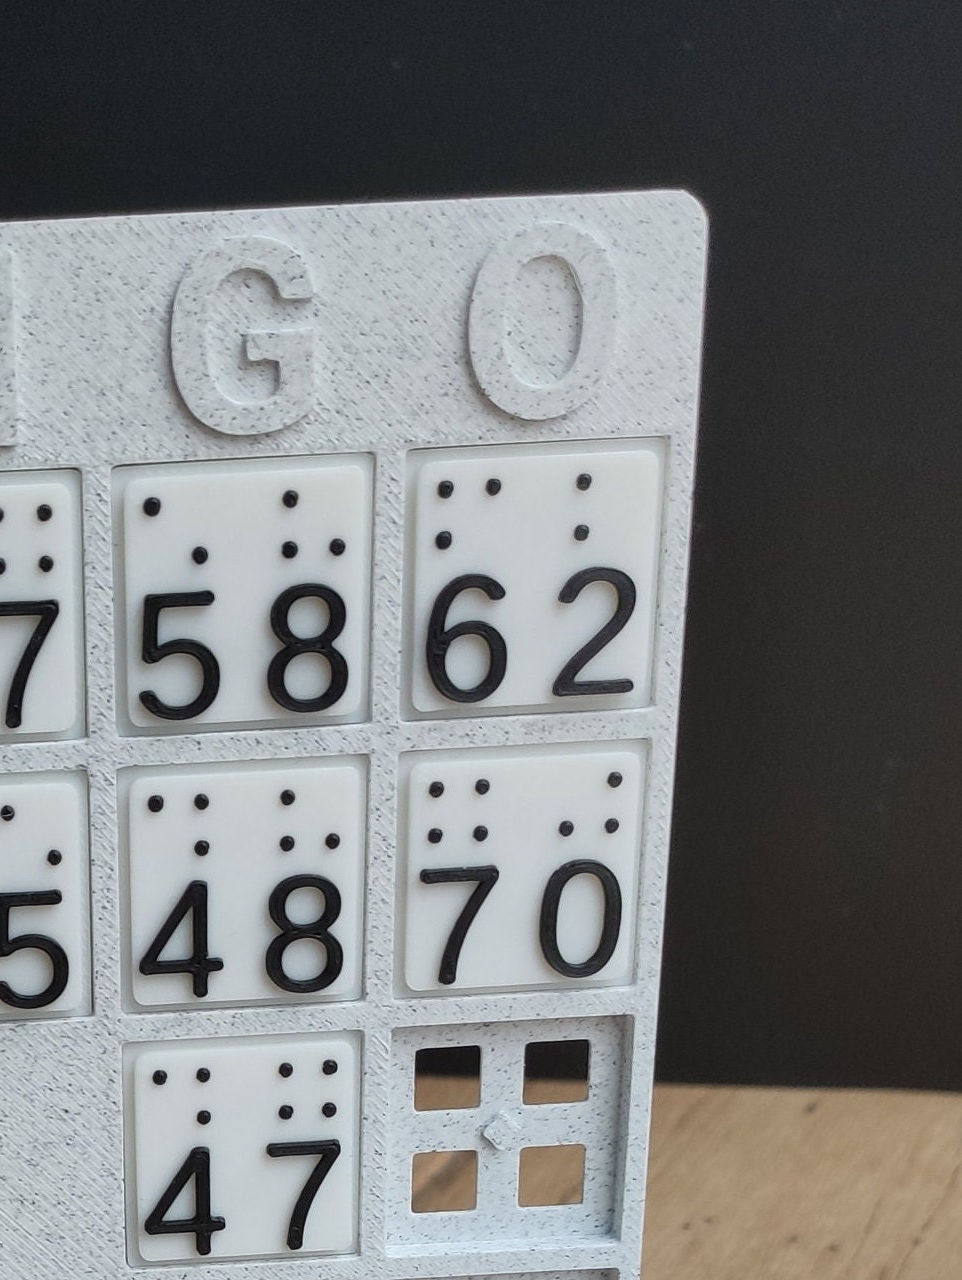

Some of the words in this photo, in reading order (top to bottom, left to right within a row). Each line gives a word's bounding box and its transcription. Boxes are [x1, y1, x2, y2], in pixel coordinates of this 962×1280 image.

[137, 581, 350, 722] 58
[424, 565, 638, 705] 62
[137, 872, 345, 1000] 48
[418, 858, 624, 987] 70
[142, 1137, 342, 1257] 47
